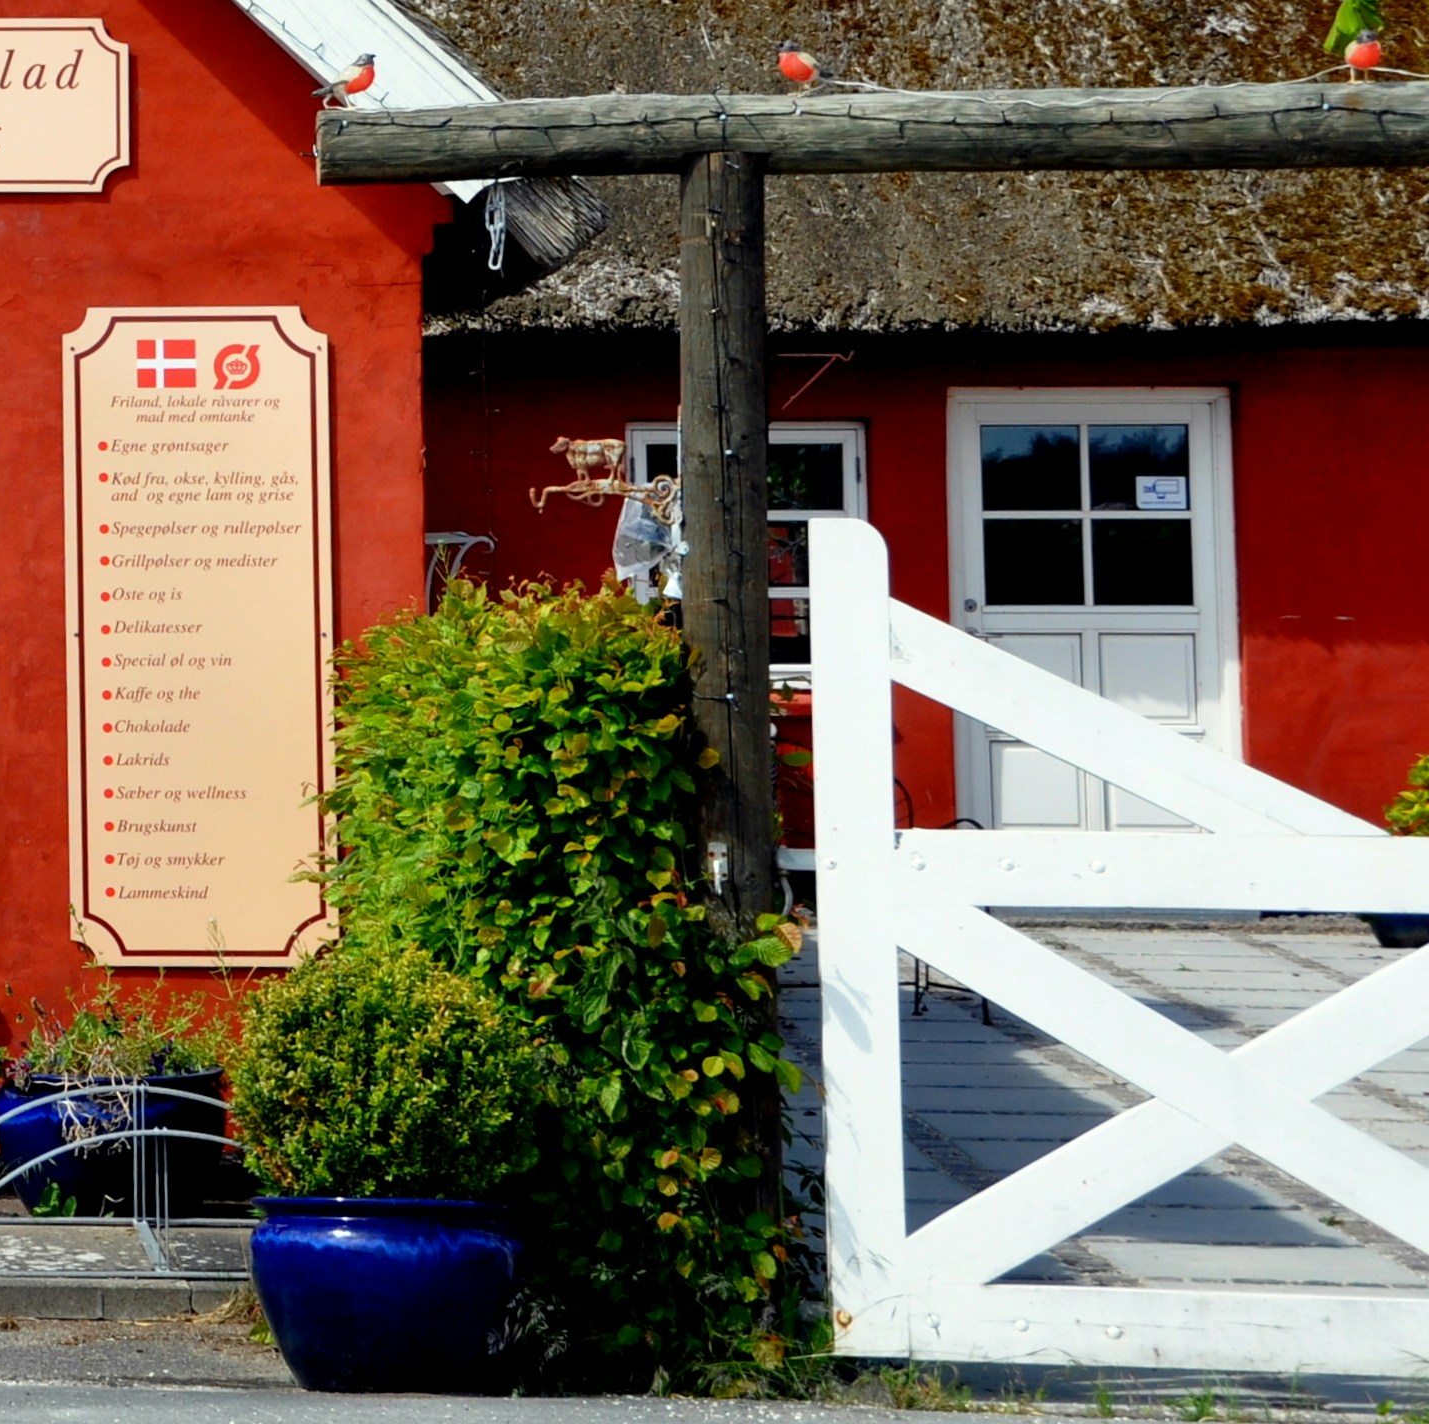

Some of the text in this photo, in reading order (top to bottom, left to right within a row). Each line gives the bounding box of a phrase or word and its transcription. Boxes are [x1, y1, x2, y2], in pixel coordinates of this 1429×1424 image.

[111, 395, 280, 410] Friland, lokale råvarer og
[136, 410, 255, 422] mad med omtanke
[111, 439, 229, 455] Egne grøntsager
[112, 471, 299, 488] Kød fra, okse, kylling, gås,
[111, 488, 294, 504] and og egne lam og grise
[111, 521, 301, 537] Spegepølser og rullepølser
[111, 554, 278, 570] Grillpølser og medister
[112, 588, 182, 603] Oste og is
[114, 620, 203, 633] Delikatesser
[114, 653, 231, 670] Special øl og vin
[115, 686, 200, 703] Kaffe og the
[114, 720, 190, 733] Chokolade
[117, 753, 170, 766] Lakrids
[116, 786, 246, 802] Sæber og wellness
[117, 819, 197, 835] Brugskunst
[118, 853, 225, 869] Tøj og smykker
[119, 886, 208, 899] Lammeskind
